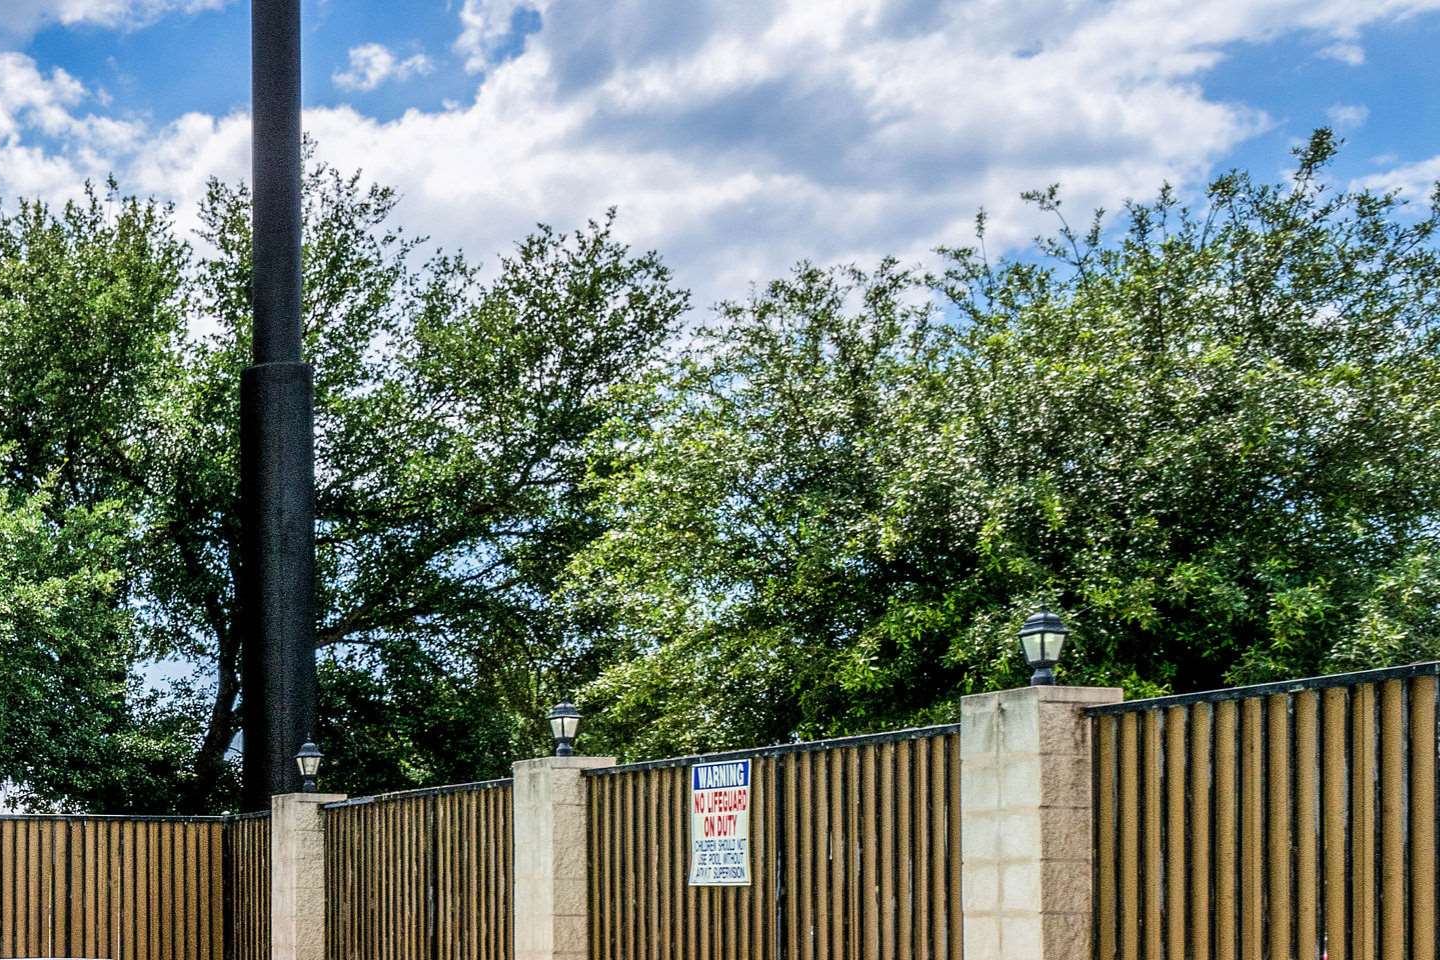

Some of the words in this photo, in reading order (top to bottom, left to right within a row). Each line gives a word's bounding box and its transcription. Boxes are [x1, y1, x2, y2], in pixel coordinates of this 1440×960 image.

[697, 764, 745, 789] WARNING
[694, 791, 705, 814] NO
[708, 789, 747, 813] LIFEGUARD
[704, 815, 715, 837] ON
[717, 814, 738, 837] DUTY
